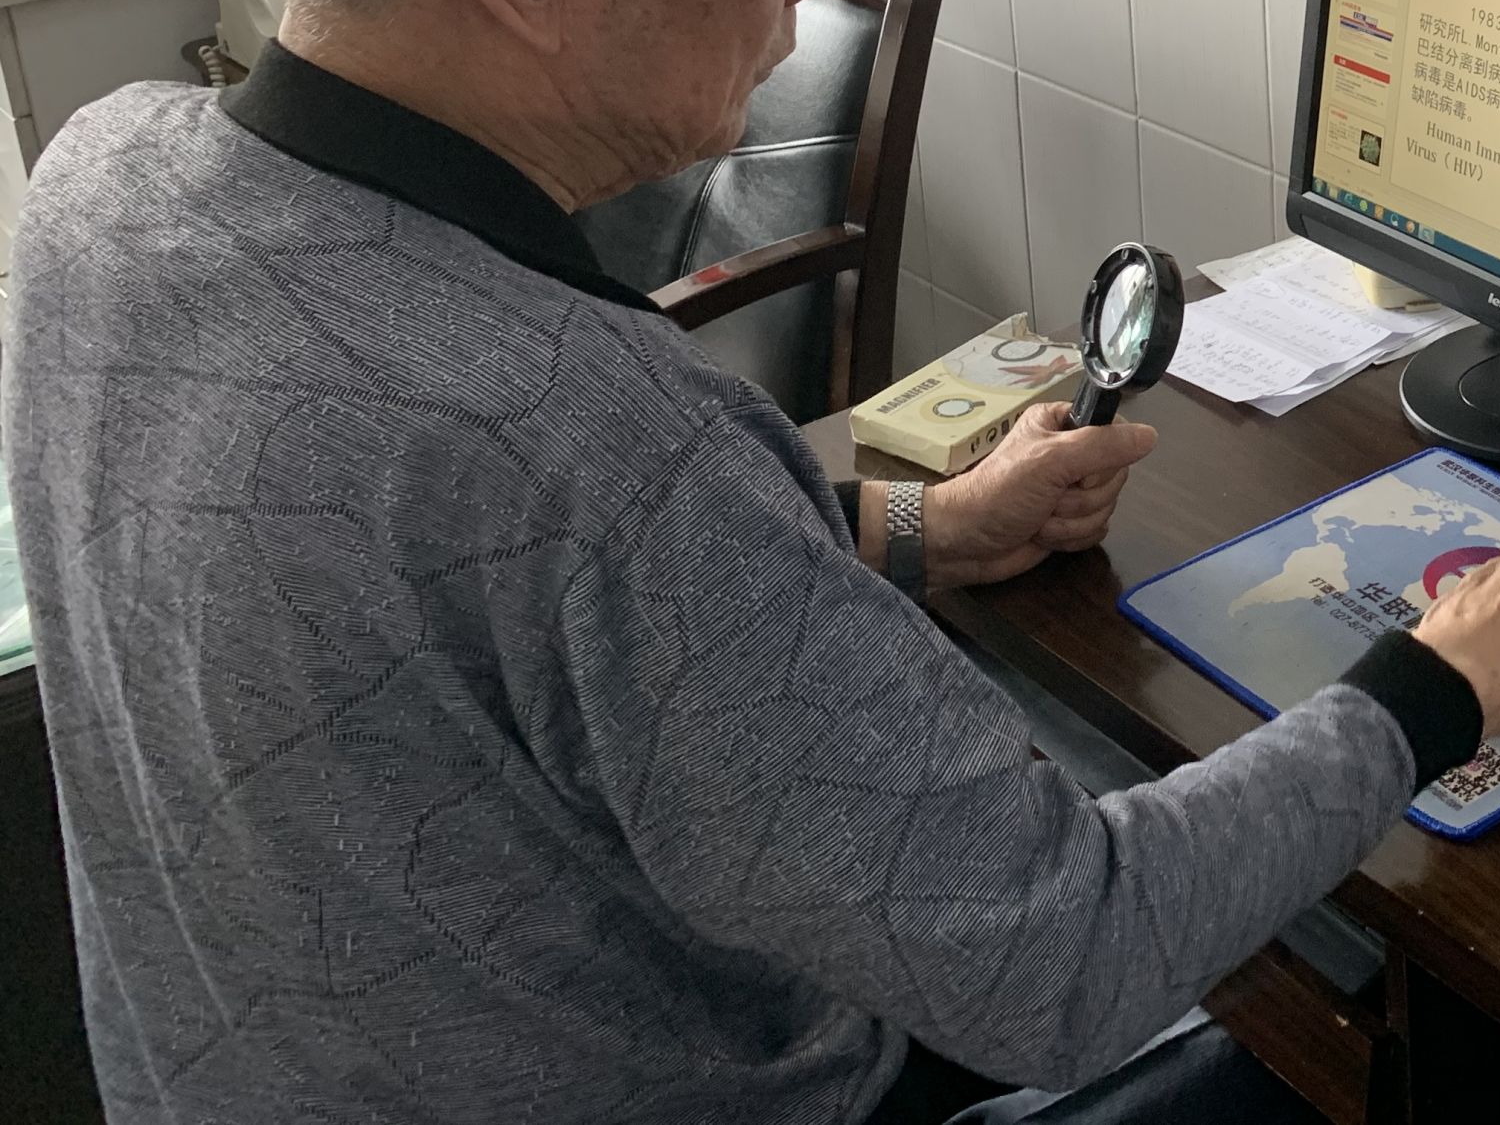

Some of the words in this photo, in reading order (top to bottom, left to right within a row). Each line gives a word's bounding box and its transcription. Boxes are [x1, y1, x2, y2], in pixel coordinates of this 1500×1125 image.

[1406, 137, 1438, 163] Virus
[1426, 121, 1472, 153] Human
[877, 378, 941, 414] MAGNIFIER
[1308, 577, 1393, 632] 打造华中地区一
[1329, 608, 1378, 641] 027-8773
